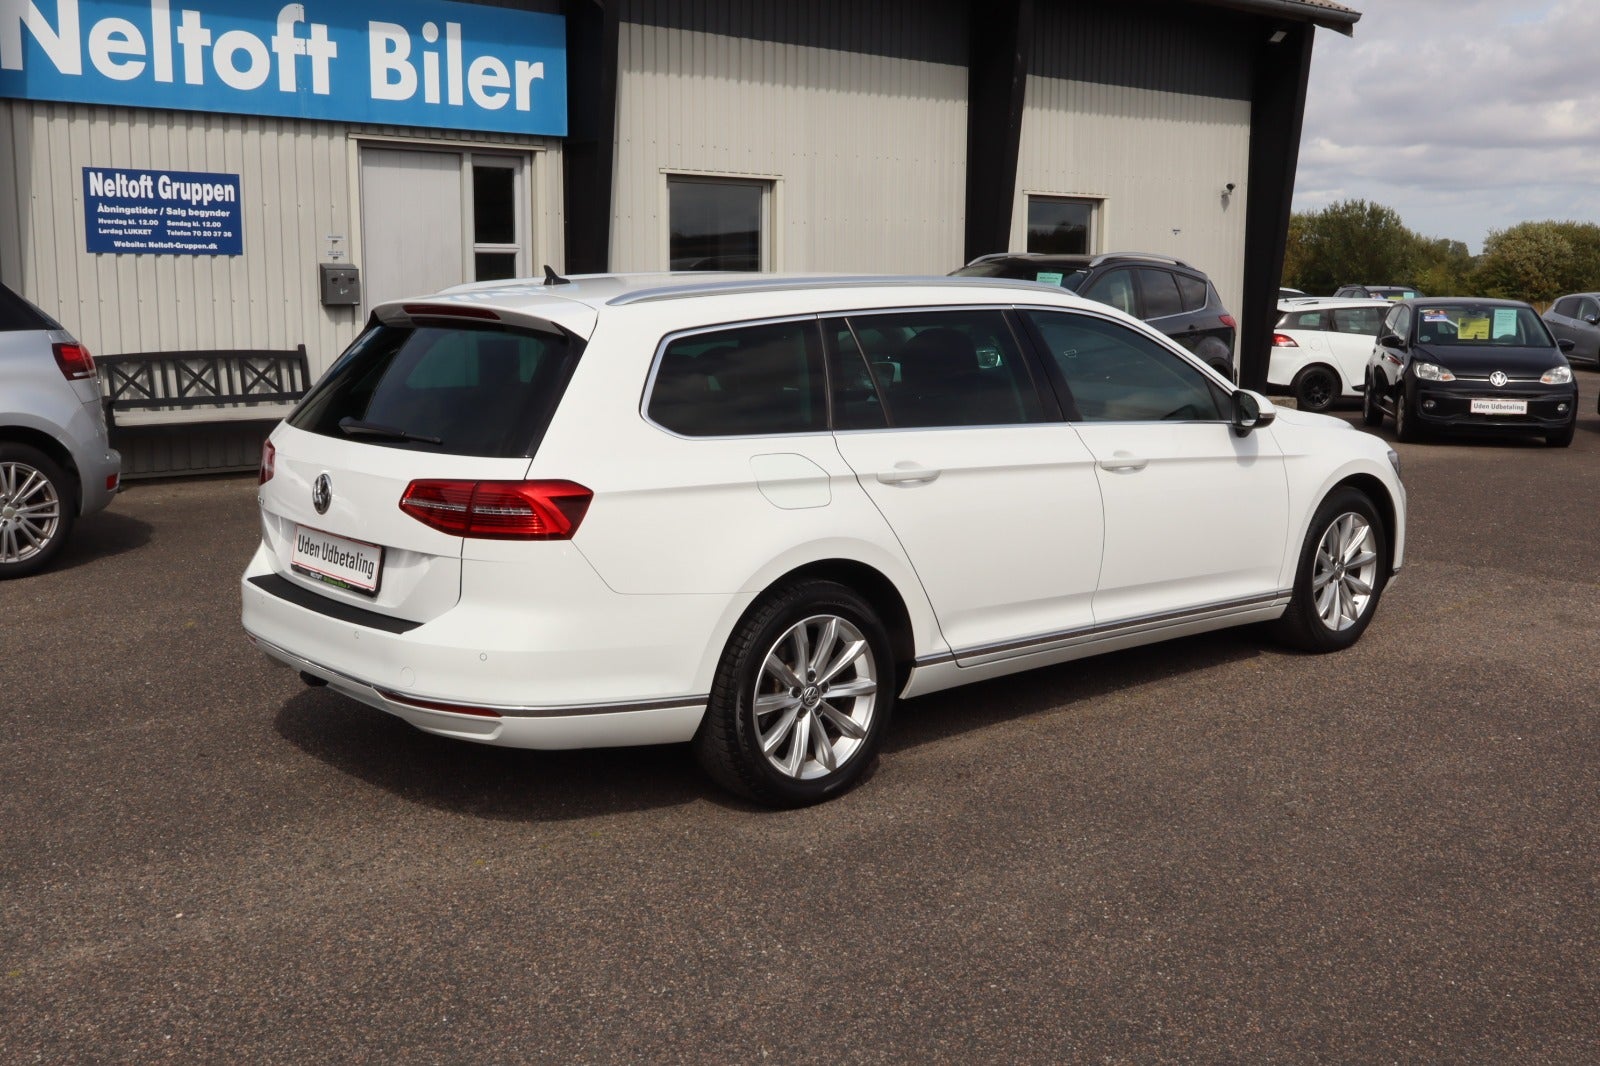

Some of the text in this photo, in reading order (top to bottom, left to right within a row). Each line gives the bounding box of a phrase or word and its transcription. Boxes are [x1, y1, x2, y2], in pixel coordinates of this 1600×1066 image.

[0, 0, 544, 112] Neltoft Biler
[89, 171, 235, 206] Neltoft Gruppen
[97, 202, 158, 215] Åbningstider
[166, 207, 186, 217] Salg
[188, 208, 230, 218] begynder
[98, 217, 127, 226] Hverdag
[113, 240, 147, 248] Website:
[1473, 402, 1525, 411] Uden Udbetaling
[297, 534, 375, 580] Uden Udbetaling
